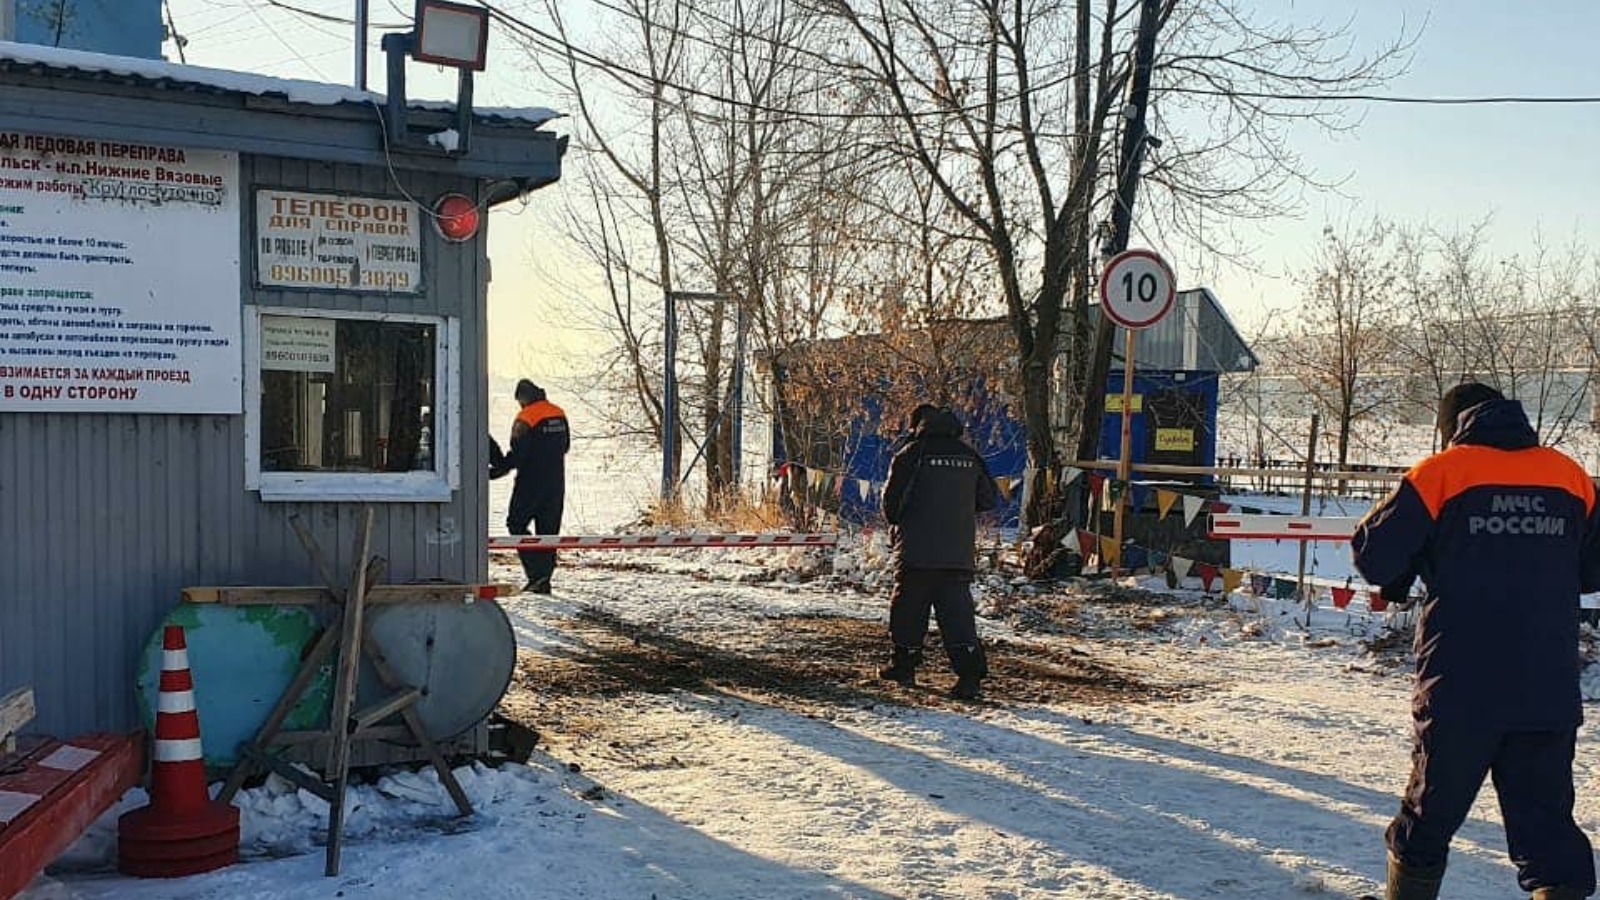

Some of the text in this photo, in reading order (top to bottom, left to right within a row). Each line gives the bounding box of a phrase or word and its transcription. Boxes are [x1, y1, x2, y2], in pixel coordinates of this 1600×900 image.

[23, 134, 96, 155] ЛЕДОВАЯ
[101, 142, 186, 164] ПЕРЕПРАВА
[155, 166, 223, 186] Вязовые
[271, 197, 408, 223] ТЕЛЕФОН
[269, 214, 411, 236] ДЛЯ СПРАВОК
[86, 237, 95, 248] 10
[271, 264, 409, 288] 8960053839
[27, 289, 94, 301] запрещается:
[1122, 271, 1158, 303] 10
[0, 366, 191, 383] ВЗИМАЕТСЯ ЗА КАЖДЫЙ ПРОЕЗД
[4, 385, 138, 400] В ОДНУ СТОРОНУ
[1490, 494, 1546, 513] МЧС
[1468, 514, 1565, 536] РОССИИ
